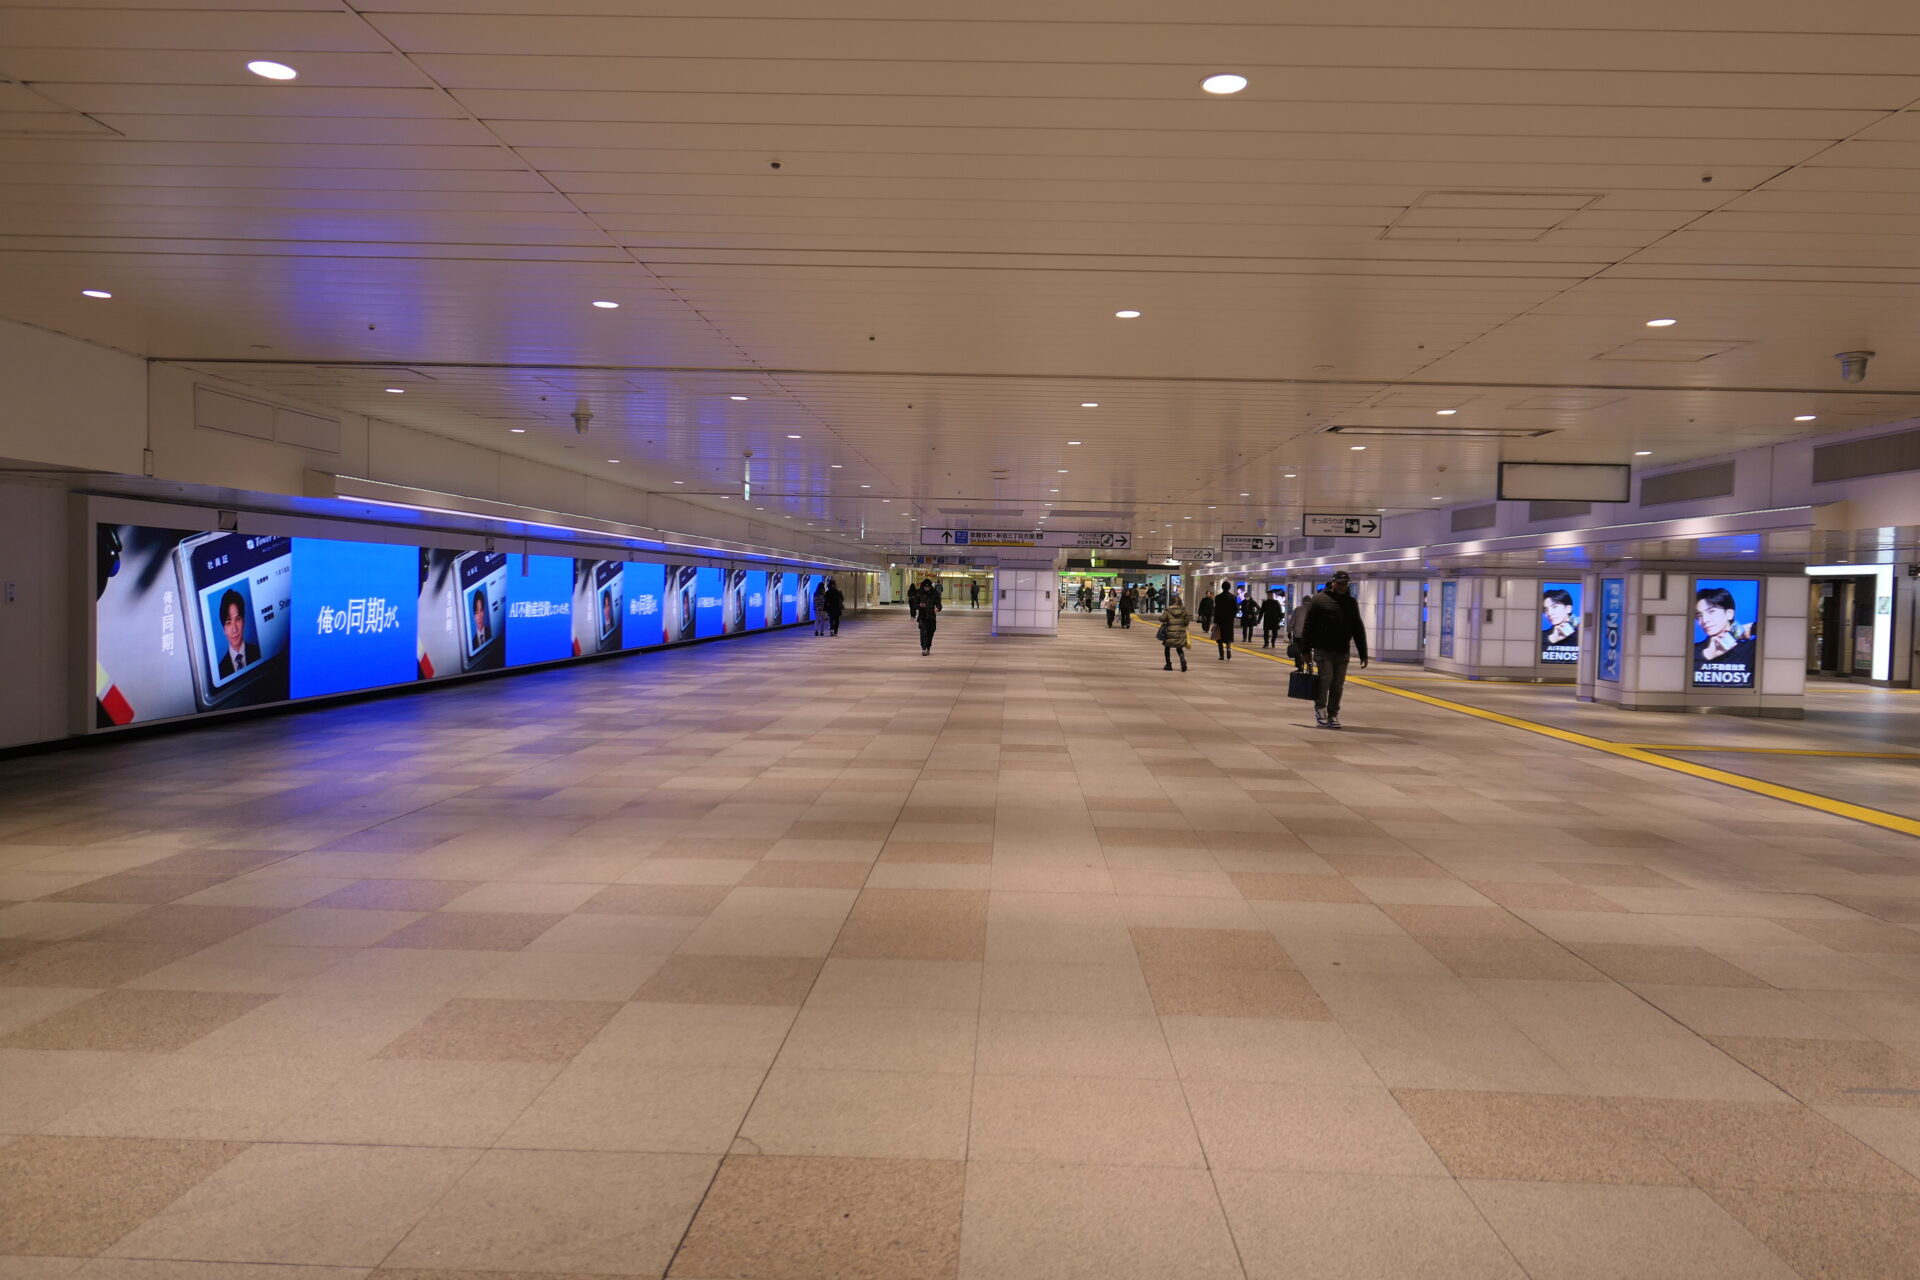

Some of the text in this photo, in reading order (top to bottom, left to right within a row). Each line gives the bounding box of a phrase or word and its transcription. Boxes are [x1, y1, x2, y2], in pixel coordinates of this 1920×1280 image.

[317, 597, 400, 635] 俺の同期が、
[1607, 583, 1620, 676] RENOSY
[1542, 652, 1578, 660] RENOS
[1695, 671, 1751, 683] RENOSY
